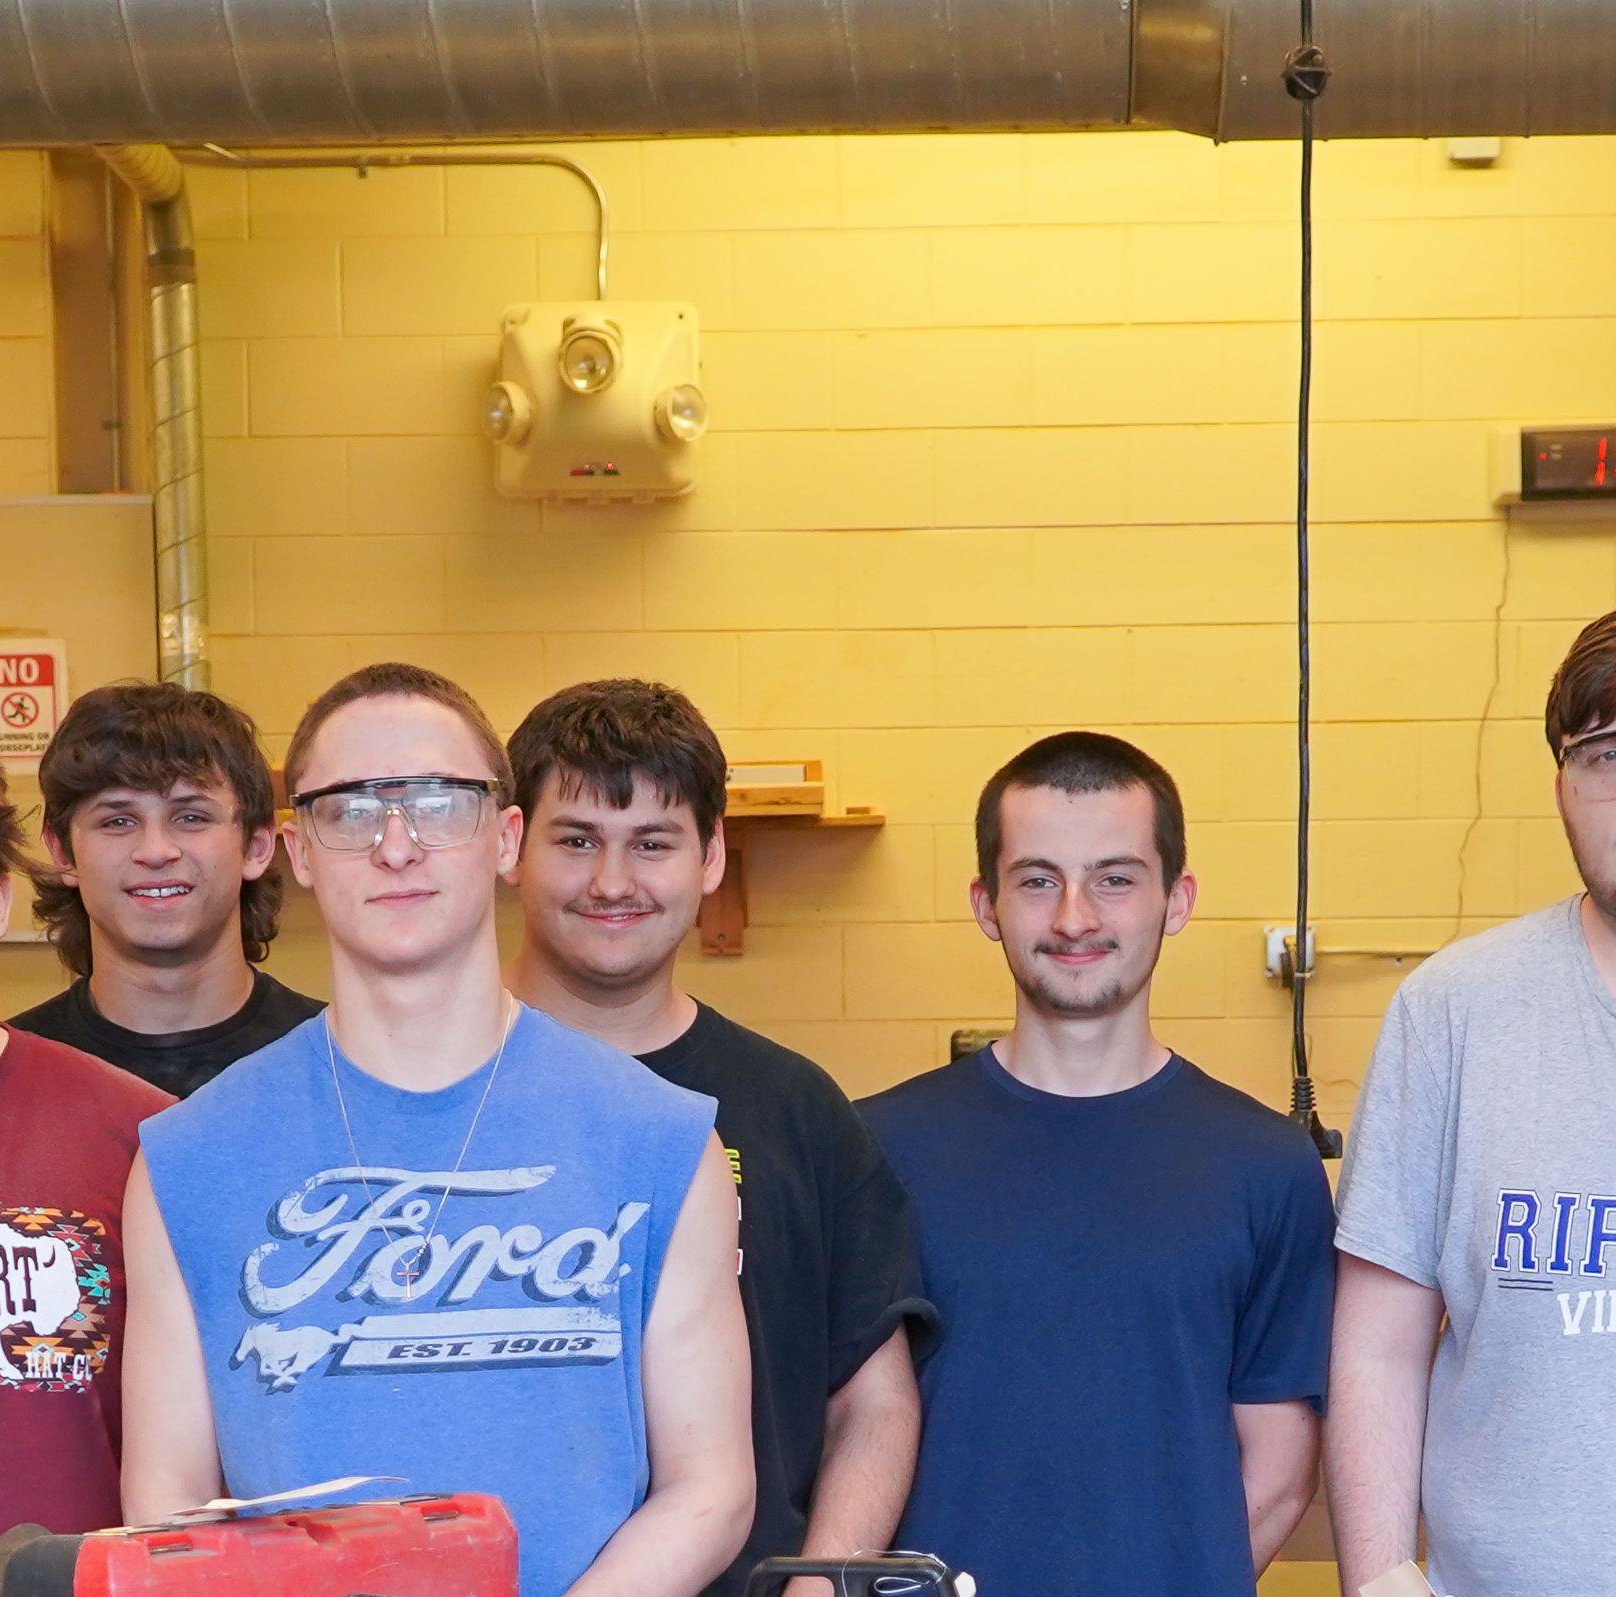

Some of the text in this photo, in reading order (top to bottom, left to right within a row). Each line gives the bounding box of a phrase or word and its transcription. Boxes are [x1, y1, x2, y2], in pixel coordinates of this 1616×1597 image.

[240, 1163, 651, 1318] Ford
[387, 1335, 598, 1361] EST. 1903
[25, 1351, 67, 1379] HAT
